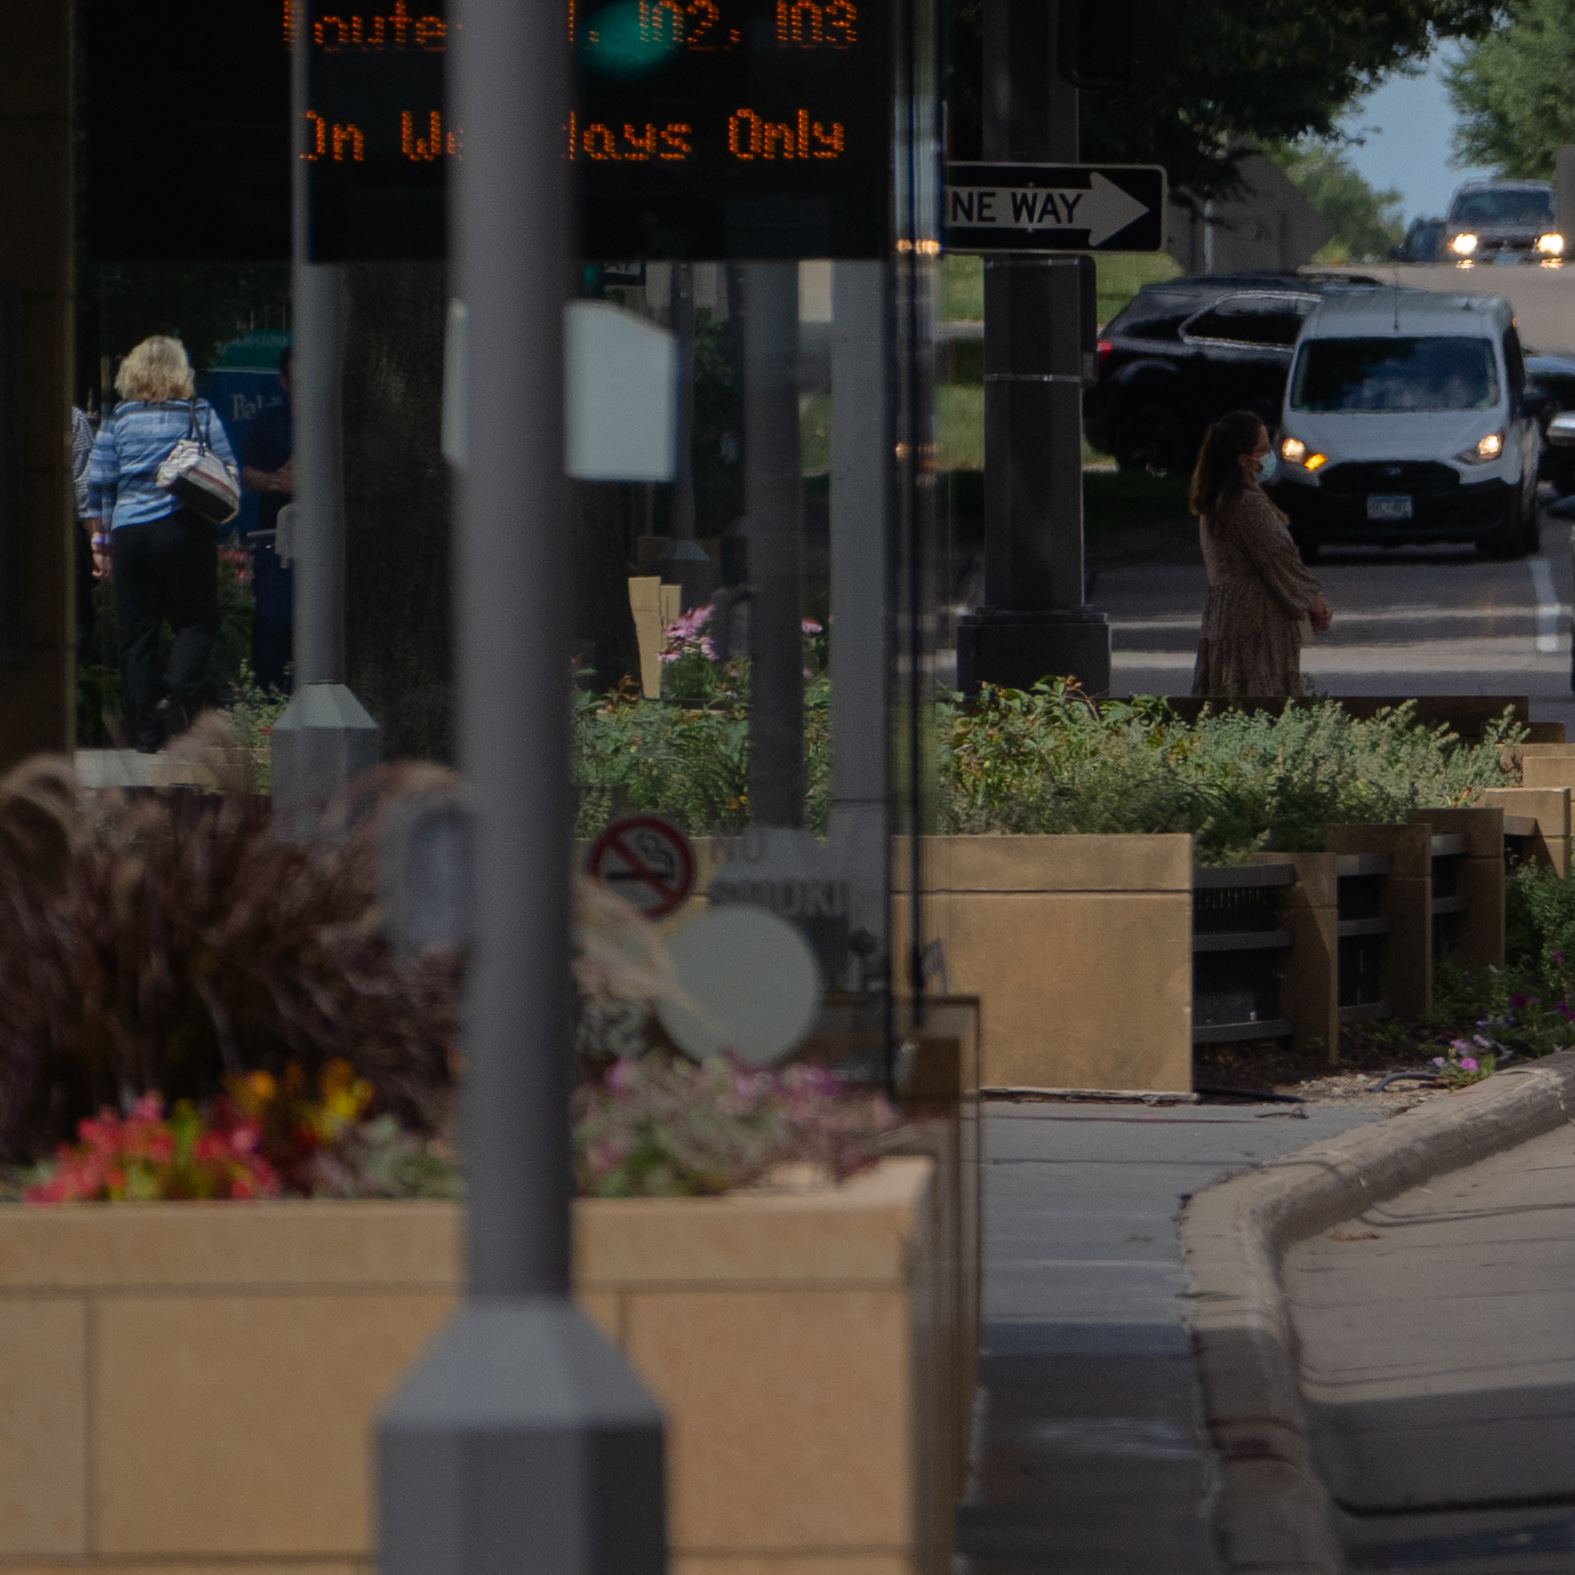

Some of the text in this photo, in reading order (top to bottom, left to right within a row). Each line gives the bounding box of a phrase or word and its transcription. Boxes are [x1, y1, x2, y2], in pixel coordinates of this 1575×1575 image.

[727, 107, 846, 162] Only
[951, 191, 1083, 225] NE WAY
